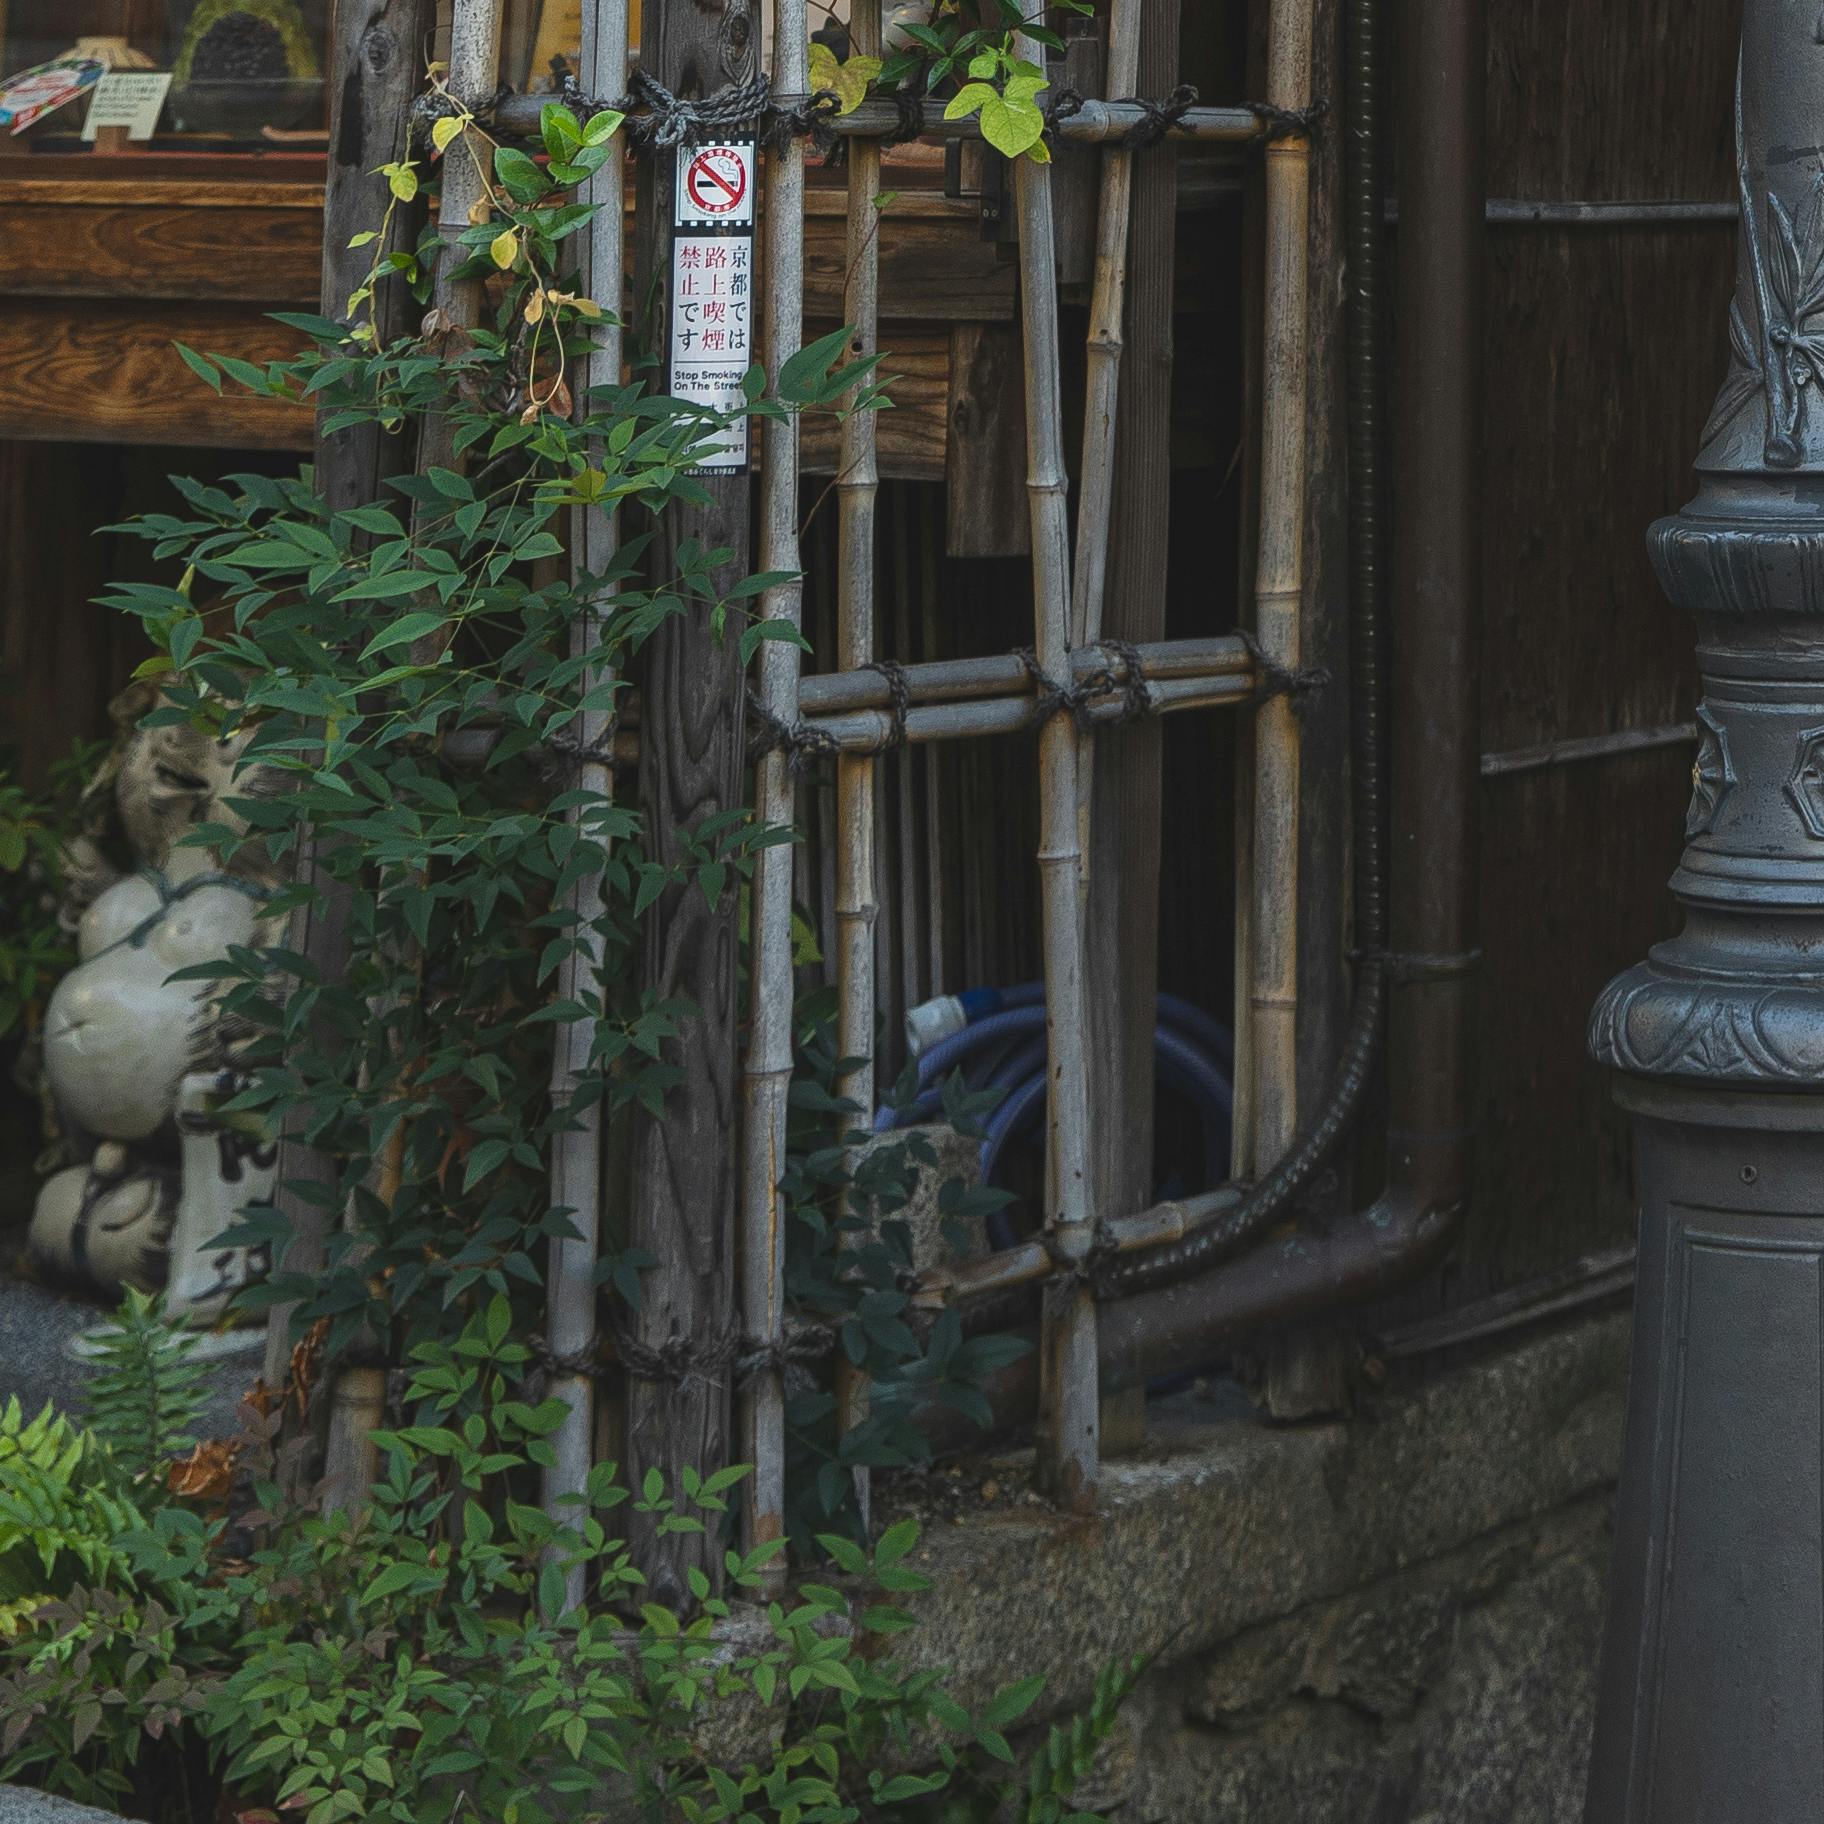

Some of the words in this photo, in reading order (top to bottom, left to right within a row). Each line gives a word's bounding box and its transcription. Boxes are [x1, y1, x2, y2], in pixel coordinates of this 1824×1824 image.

[677, 244, 702, 353] 禁止です
[702, 245, 727, 352] 路上喫煙
[729, 244, 749, 351] 京都では
[673, 381, 688, 391] On
[690, 381, 710, 391] The
[674, 370, 699, 381] Stop
[701, 370, 743, 382] Smoking
